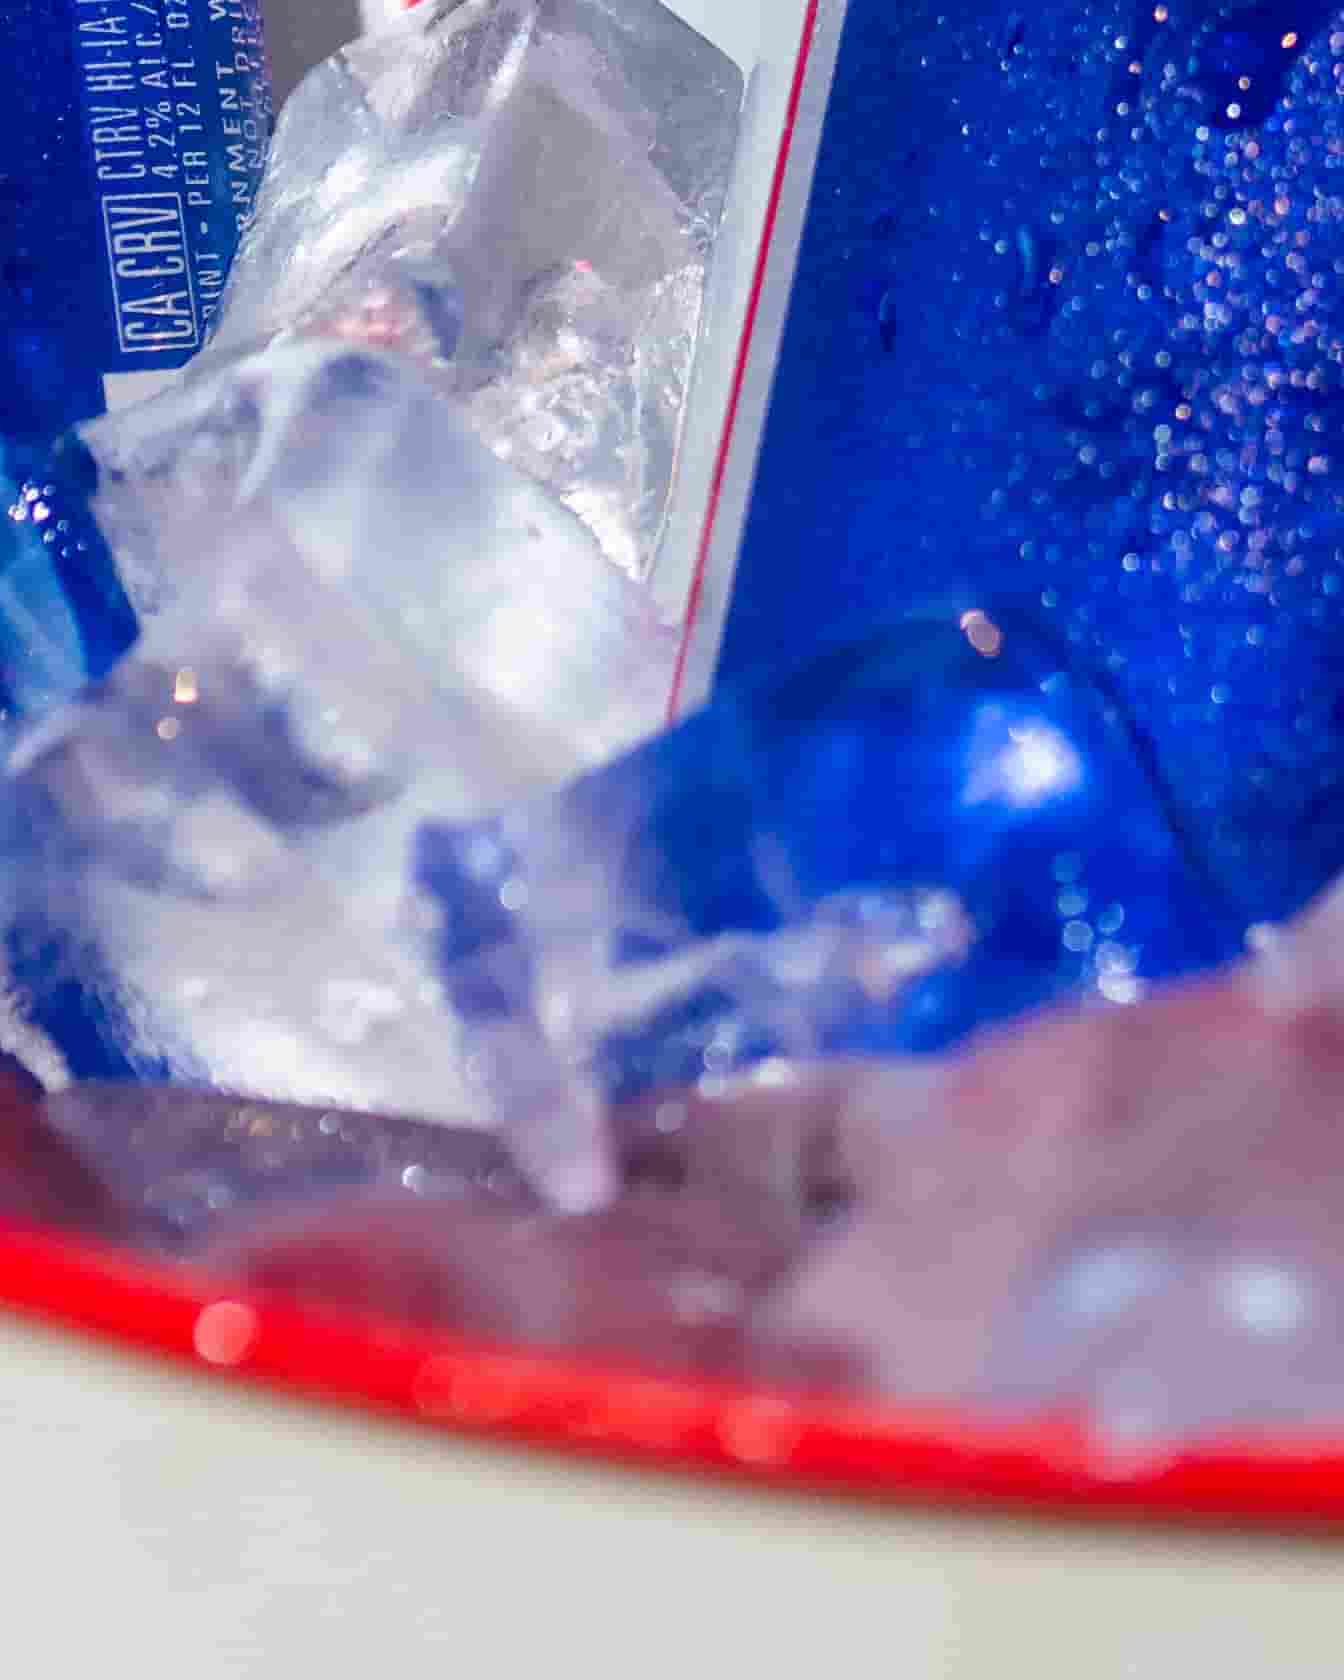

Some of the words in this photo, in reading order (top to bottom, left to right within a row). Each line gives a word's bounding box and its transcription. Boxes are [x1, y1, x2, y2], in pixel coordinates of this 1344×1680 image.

[142, 100, 179, 180] 4.2%
[174, 100, 203, 133] 12
[180, 148, 212, 207] PER
[108, 199, 185, 280] CRV
